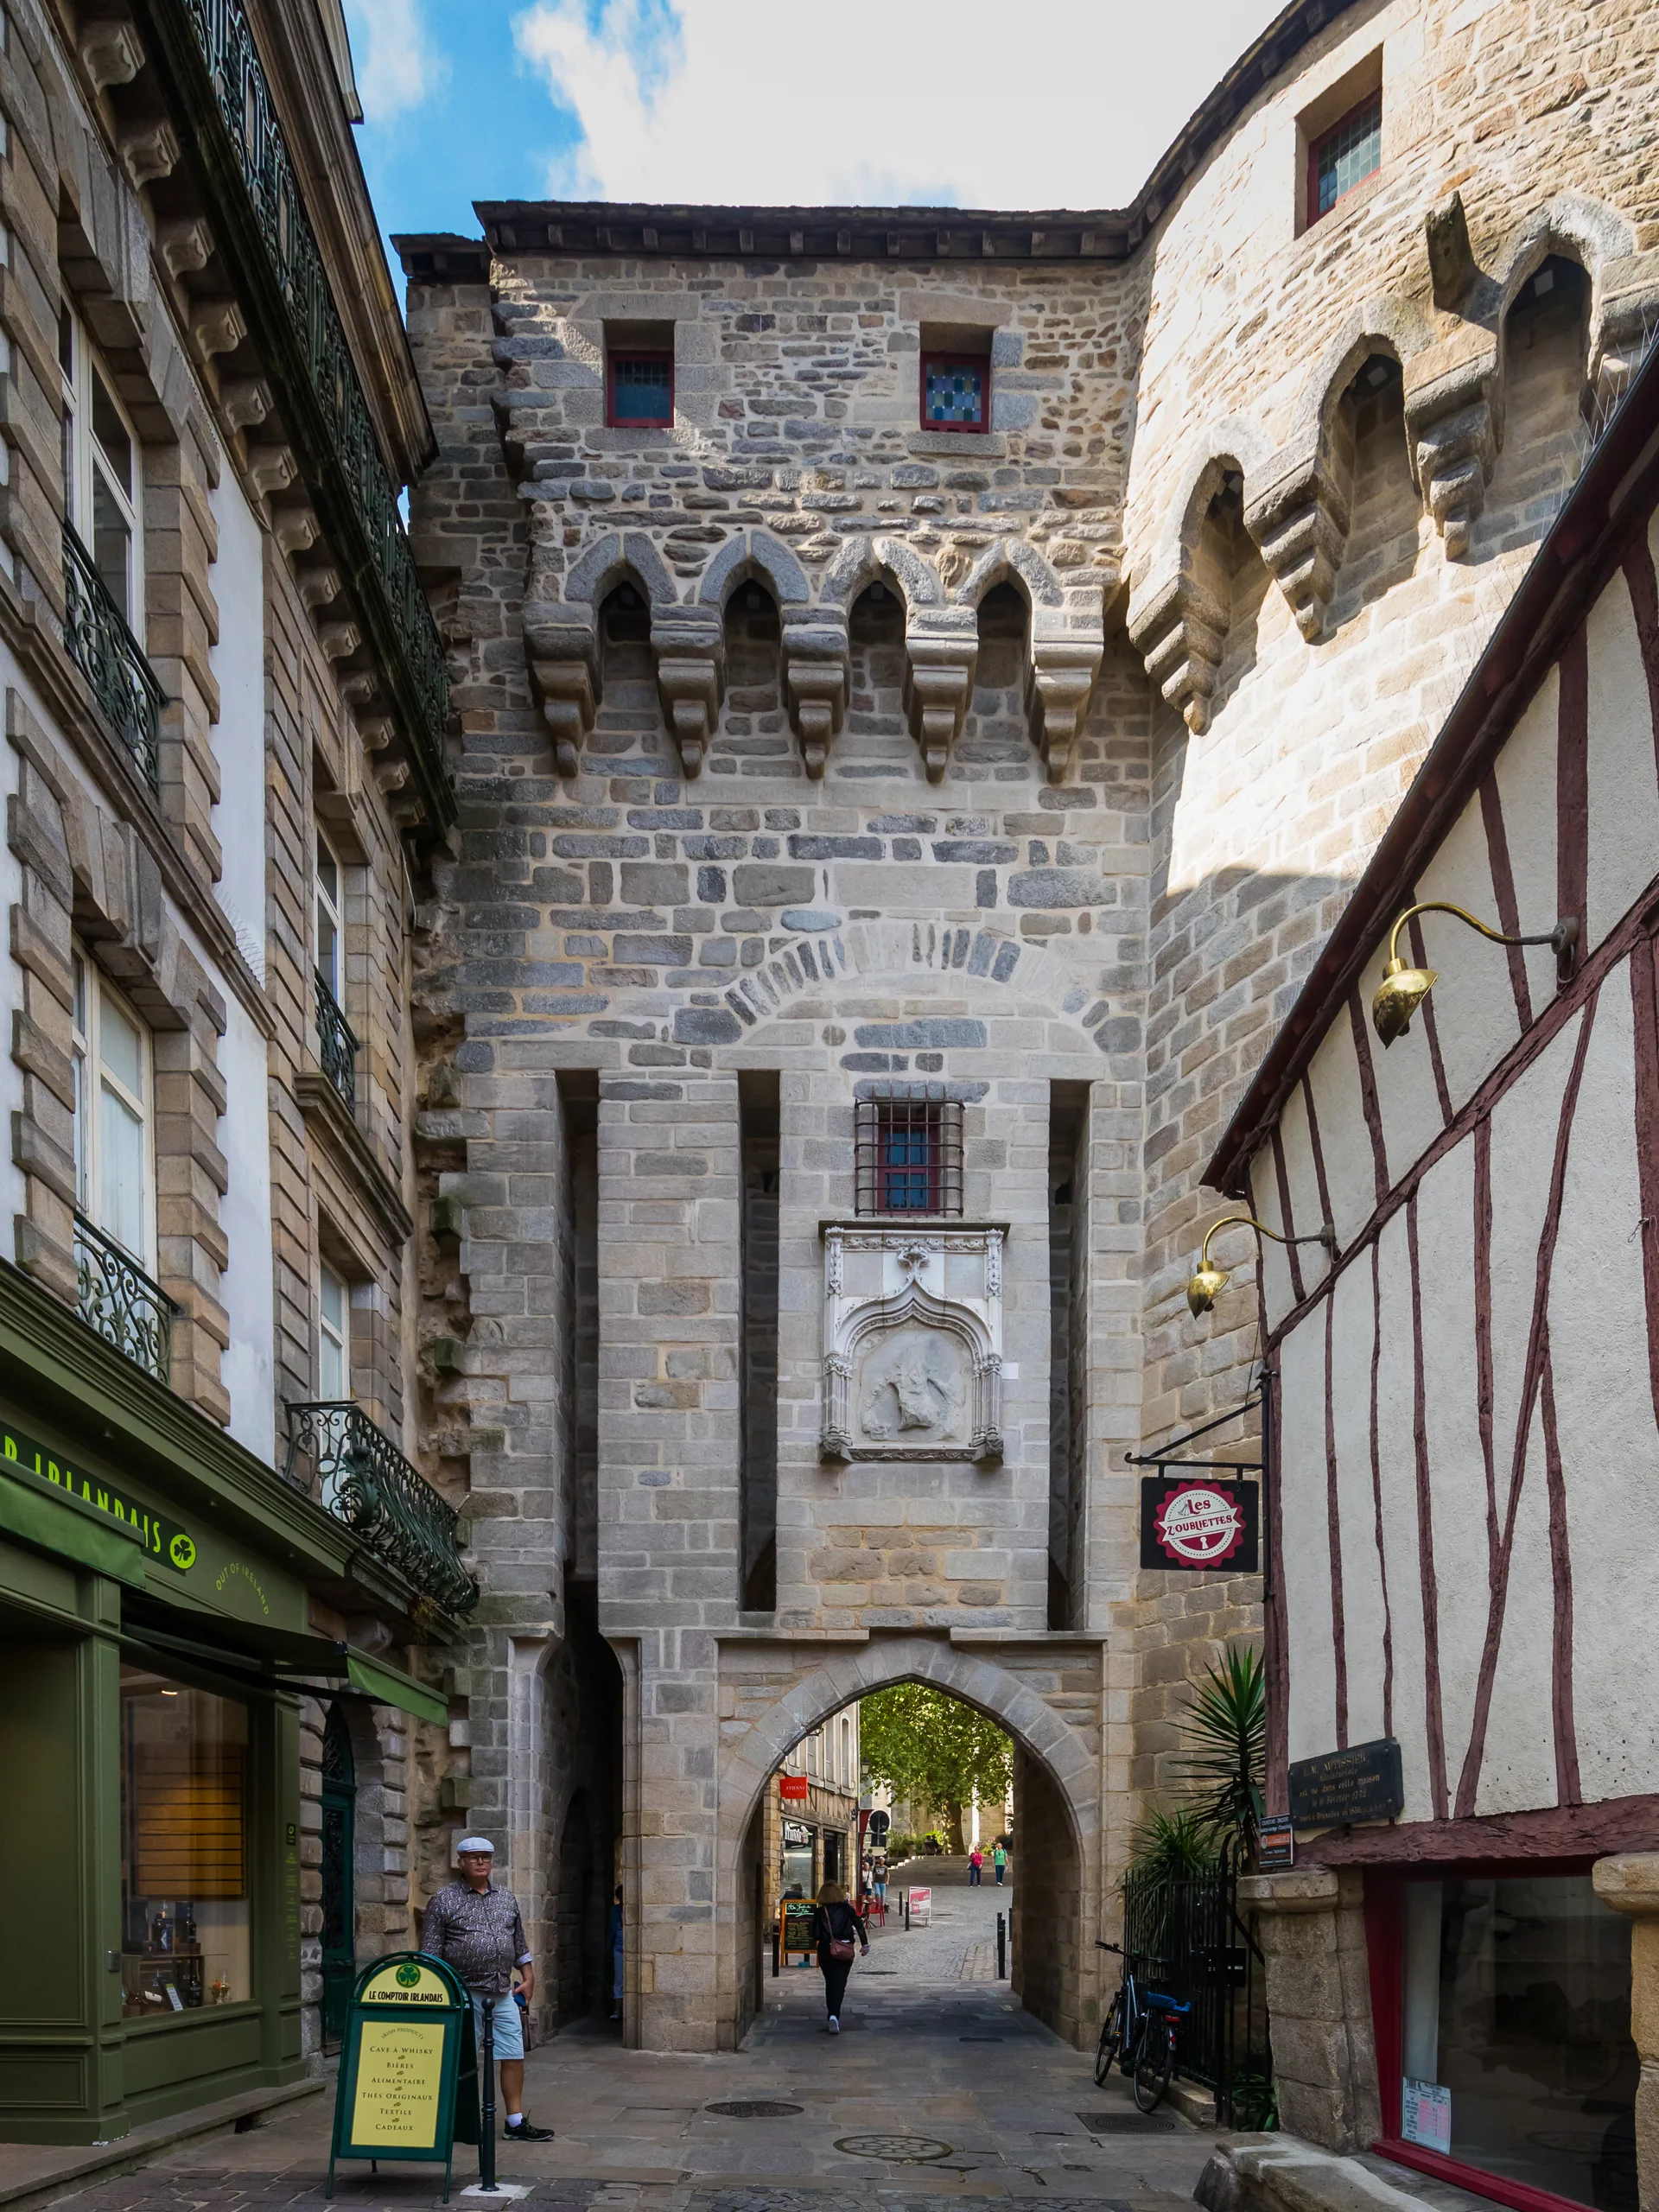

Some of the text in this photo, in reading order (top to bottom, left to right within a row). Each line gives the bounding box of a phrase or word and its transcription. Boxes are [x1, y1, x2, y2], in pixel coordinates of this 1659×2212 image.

[1187, 1498, 1211, 1515] Les
[216, 1562, 269, 1614] OUT OF IRELAND
[1357, 1774, 1380, 1785] maison
[369, 1990, 443, 2003] LE COMPTOIR IRLANDAIS
[381, 2027, 424, 2040] IRISH PRODUCTS
